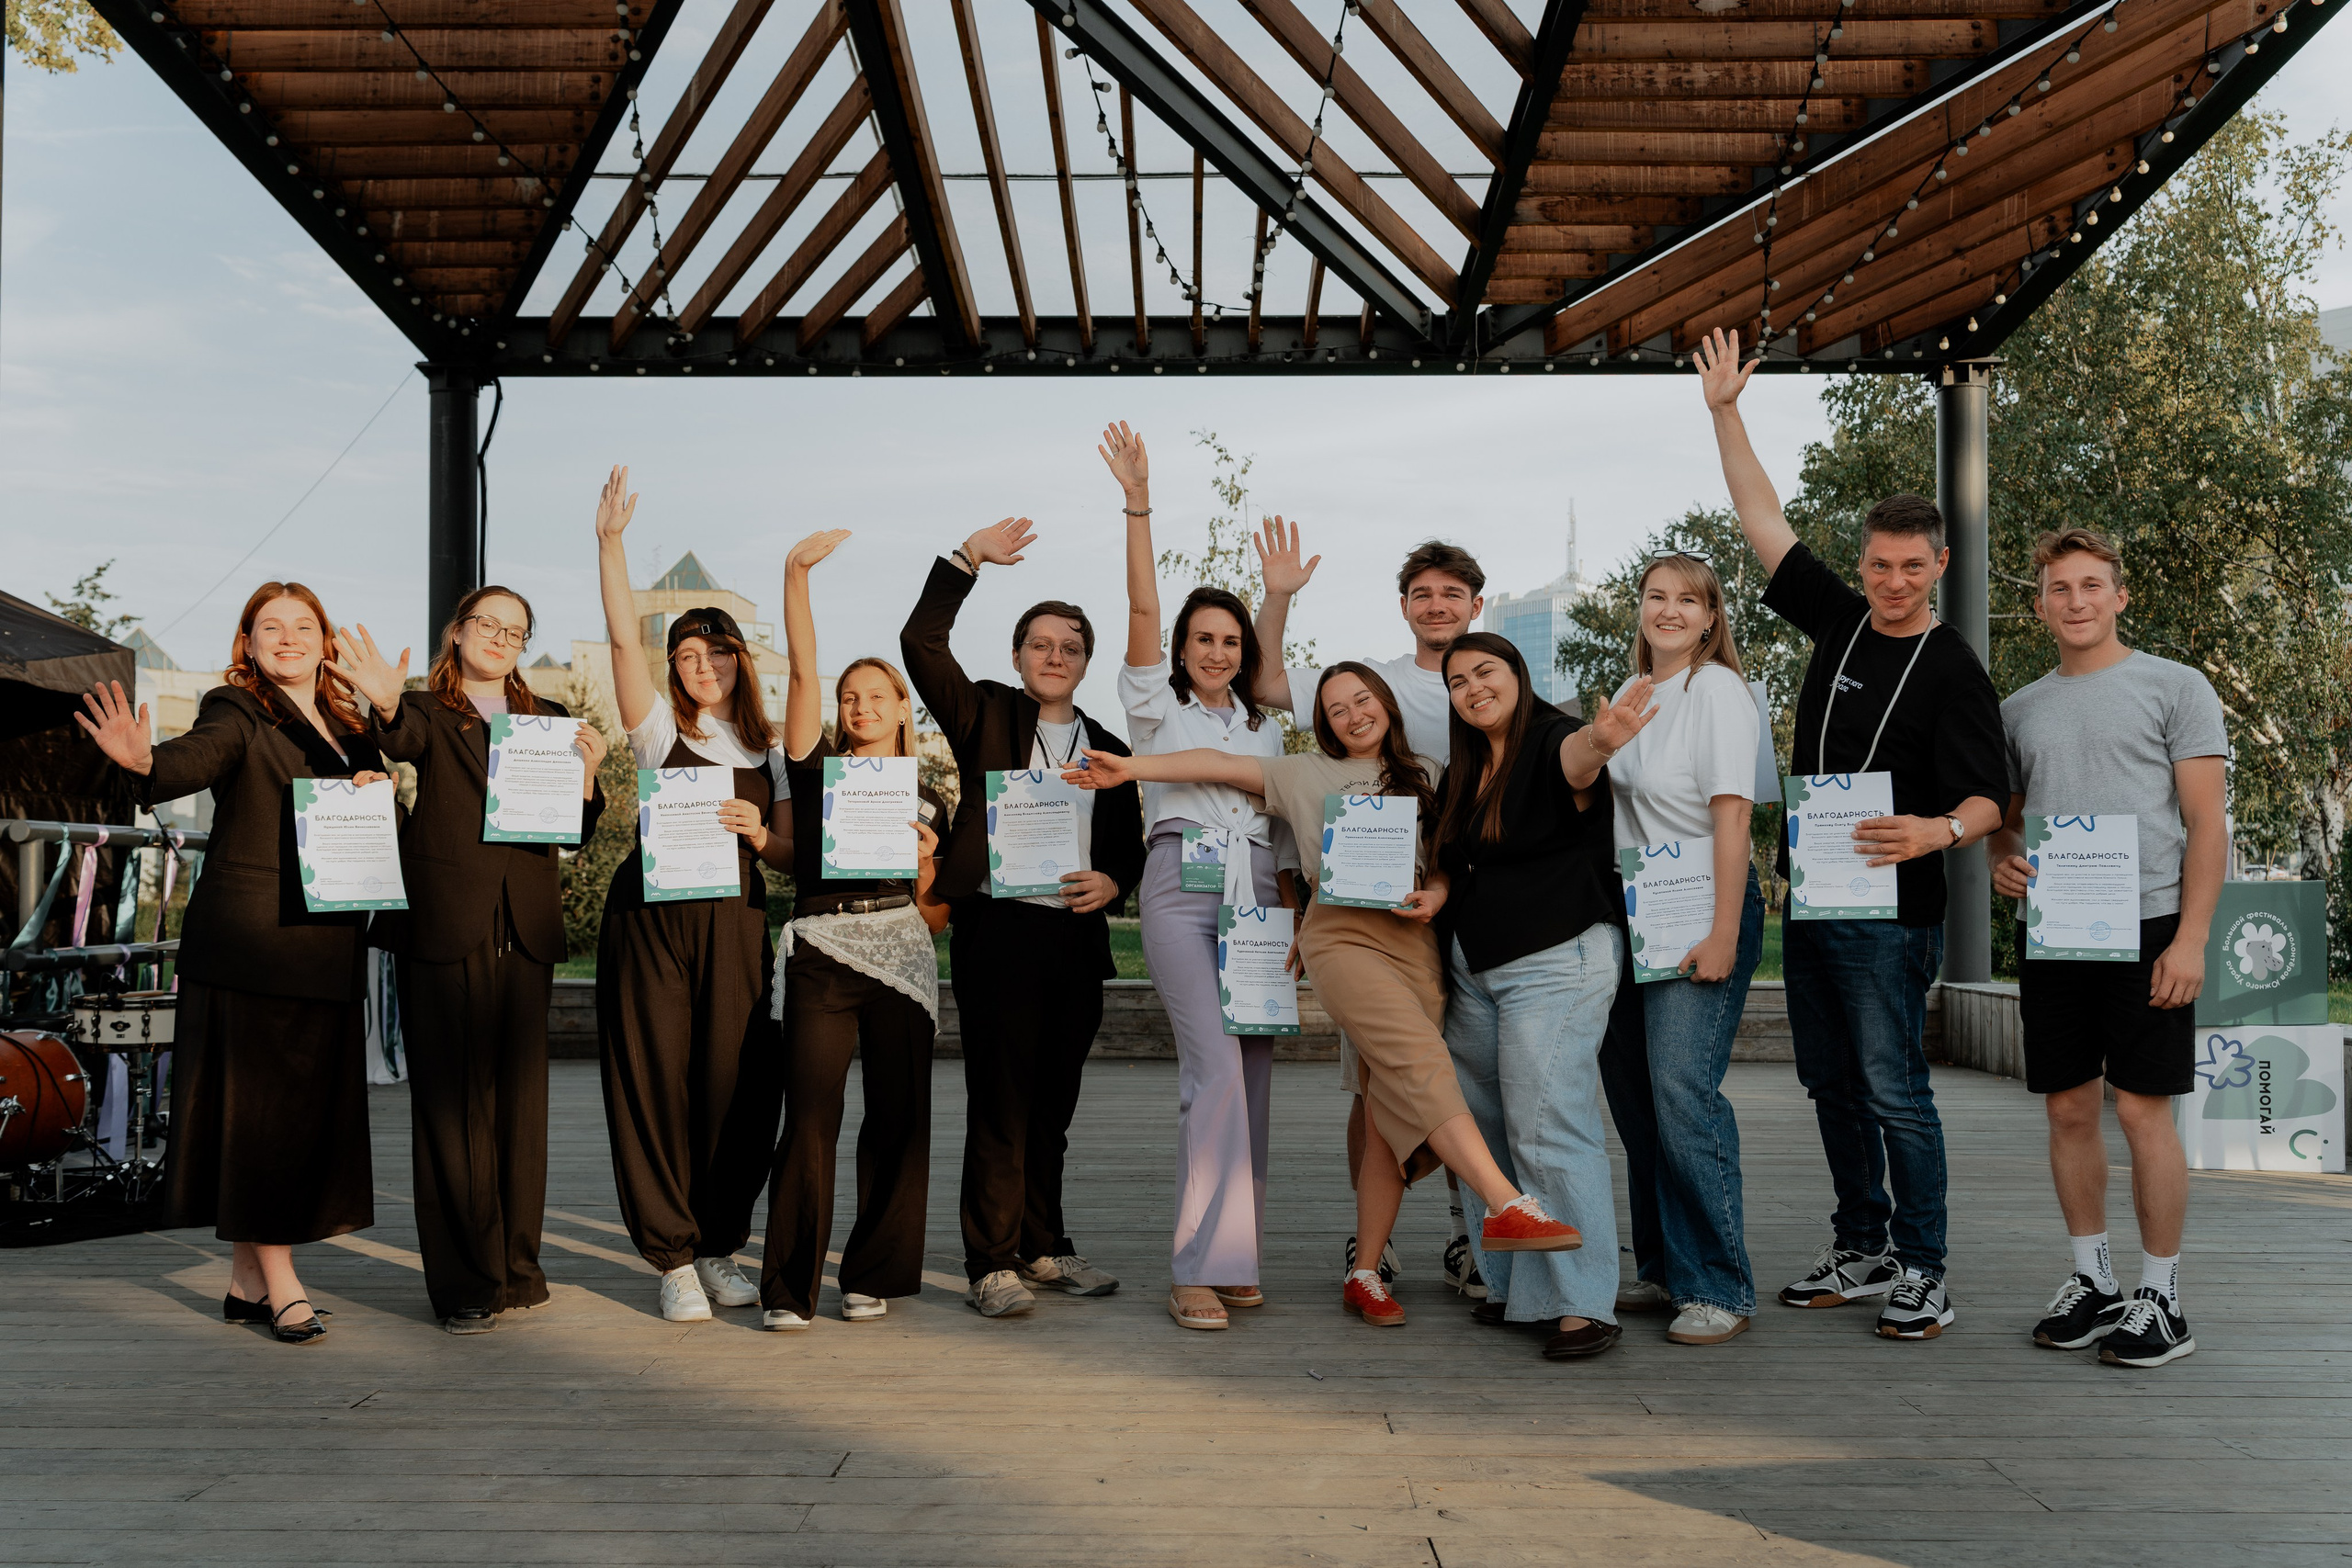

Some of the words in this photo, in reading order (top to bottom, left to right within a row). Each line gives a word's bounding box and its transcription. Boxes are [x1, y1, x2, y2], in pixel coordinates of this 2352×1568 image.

[508, 748, 578, 758] БЛАГОДАРНОСТЬ
[658, 800, 723, 810] БЛАГОДАРНОСТ
[1004, 800, 1069, 809] БЛАГОДАРНОСТЬ
[1807, 810, 1885, 819] БЛАГОДАРНОСТЬ
[1341, 826, 1409, 834] БЛАГОДАРНОСТЬ
[2048, 852, 2131, 861] БЛАГОДАРНОСТЬ
[1643, 874, 1712, 888] БЛАГОДАРНОСТЬ
[2245, 911, 2289, 931] фестиваль
[2222, 915, 2245, 952] Большой
[1233, 939, 1290, 948] БЛАГОДАРНОСТЬ
[2279, 931, 2297, 981] волонтёров
[2225, 960, 2245, 986] Урала
[2245, 979, 2280, 990] Южного
[2258, 1060, 2276, 1134] ПОМОГАЙ
